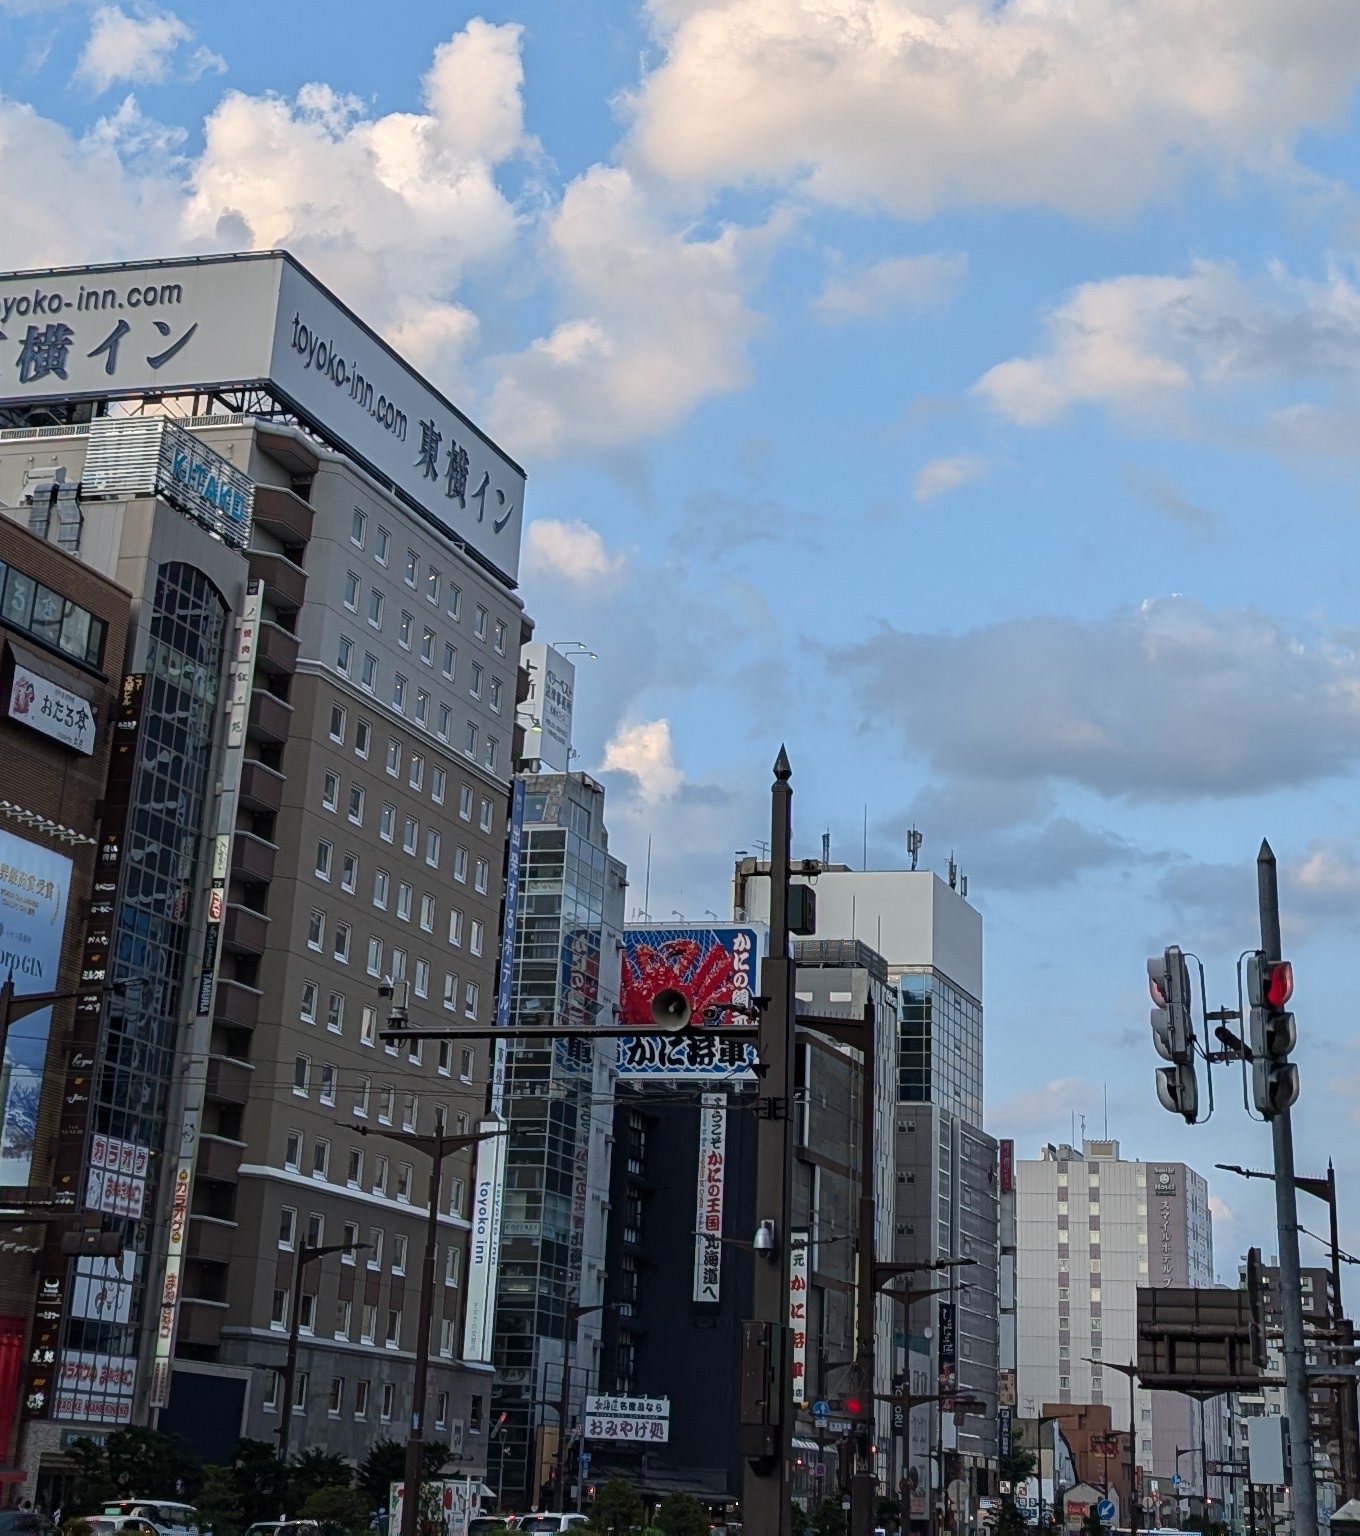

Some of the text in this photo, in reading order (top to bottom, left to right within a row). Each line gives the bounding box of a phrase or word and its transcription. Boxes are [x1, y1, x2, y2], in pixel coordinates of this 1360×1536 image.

[291, 311, 409, 443] toyoko-inn.com
[413, 418, 515, 535] 東横イン
[22, 955, 43, 978] GIN
[93, 1135, 147, 1177] カラオケ
[171, 1181, 188, 1232] カラオケ
[474, 1181, 491, 1265] toyoko inn
[590, 1419, 664, 1440] おみやげ処
